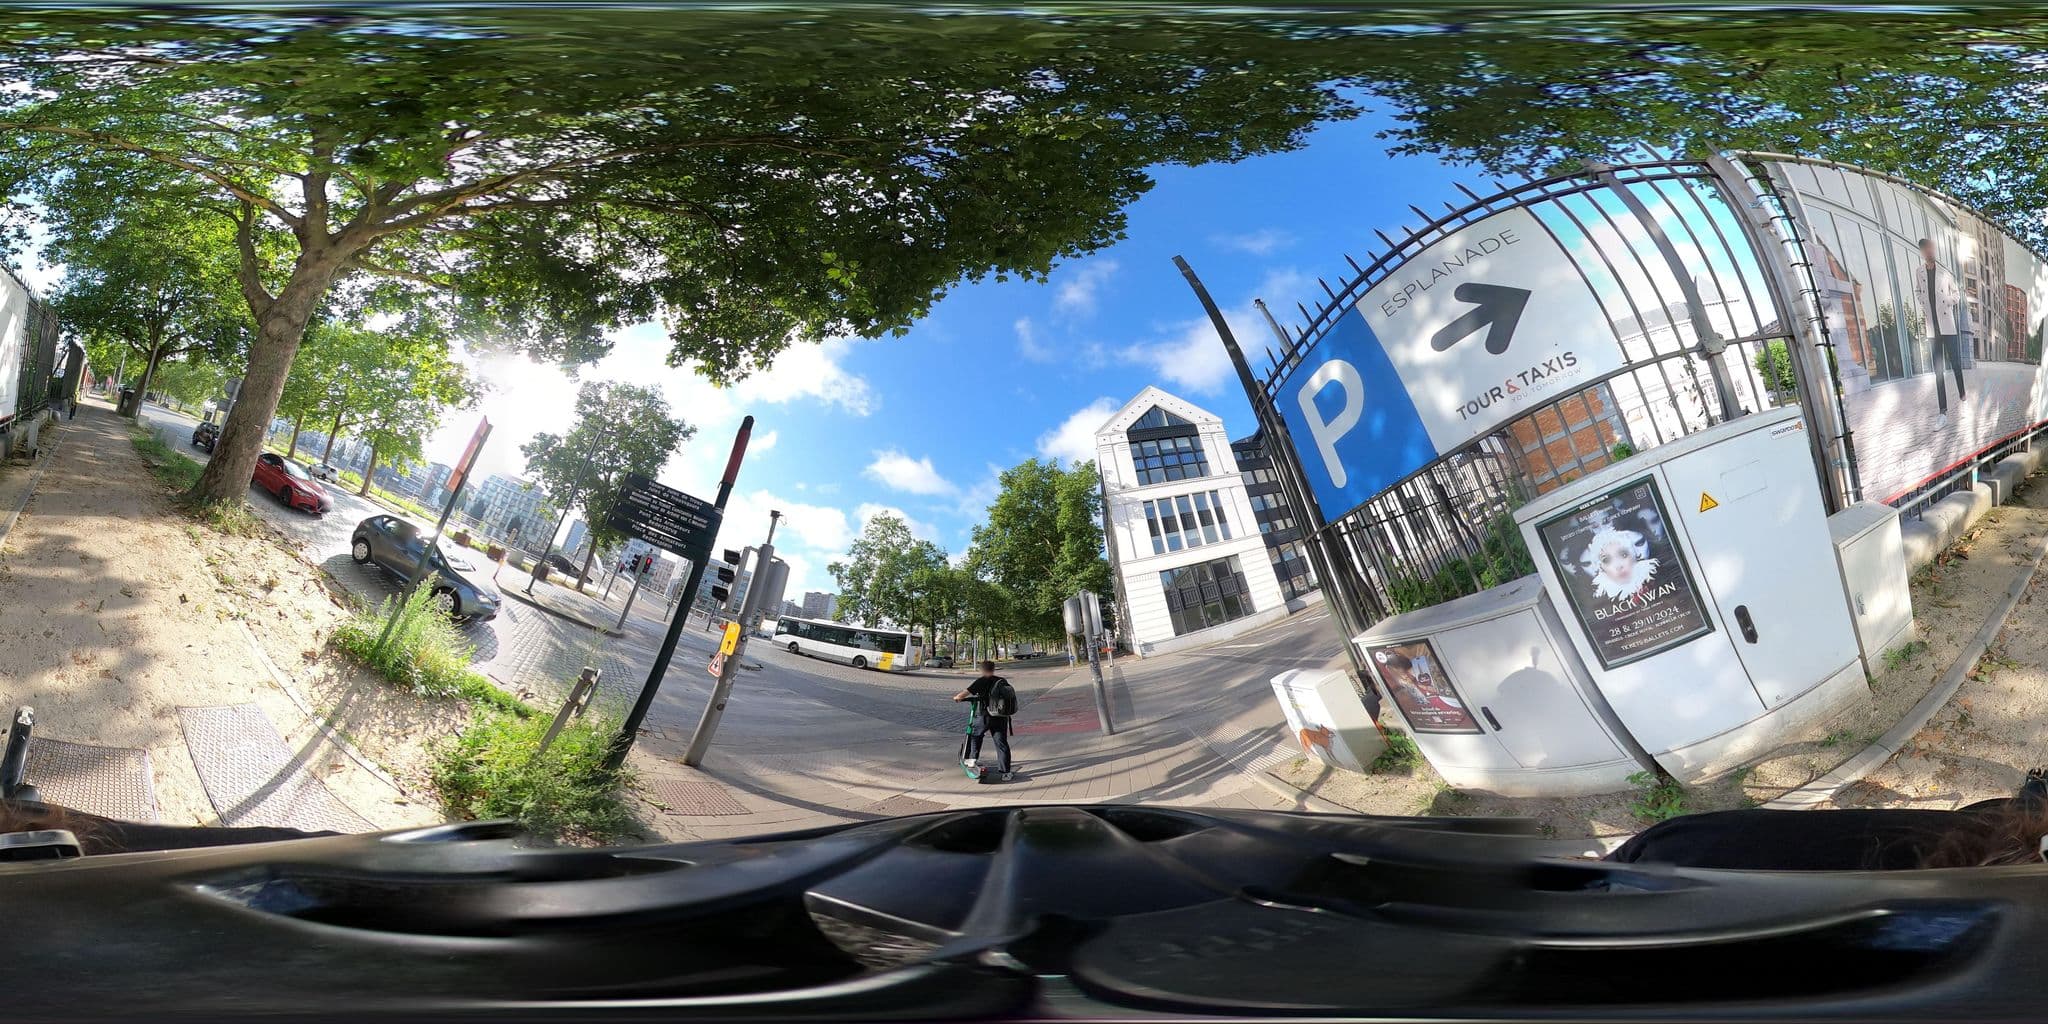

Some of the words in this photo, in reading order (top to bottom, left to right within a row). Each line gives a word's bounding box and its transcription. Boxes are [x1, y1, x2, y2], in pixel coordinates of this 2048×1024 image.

[1381, 229, 1521, 318] ESPLANADE
[1511, 392, 1528, 402] YOU
[1297, 358, 1365, 489] P
[639, 509, 651, 518] Pont
[652, 515, 663, 523] des
[663, 520, 691, 534] Armateurs
[647, 530, 658, 538] des
[659, 535, 687, 549] Armateurs
[1593, 599, 1637, 620] BLACK
[1637, 581, 1676, 608] SWAN
[1609, 627, 1621, 637] 28
[1622, 624, 1631, 633] &
[1632, 605, 1680, 629] 29/11/2024
